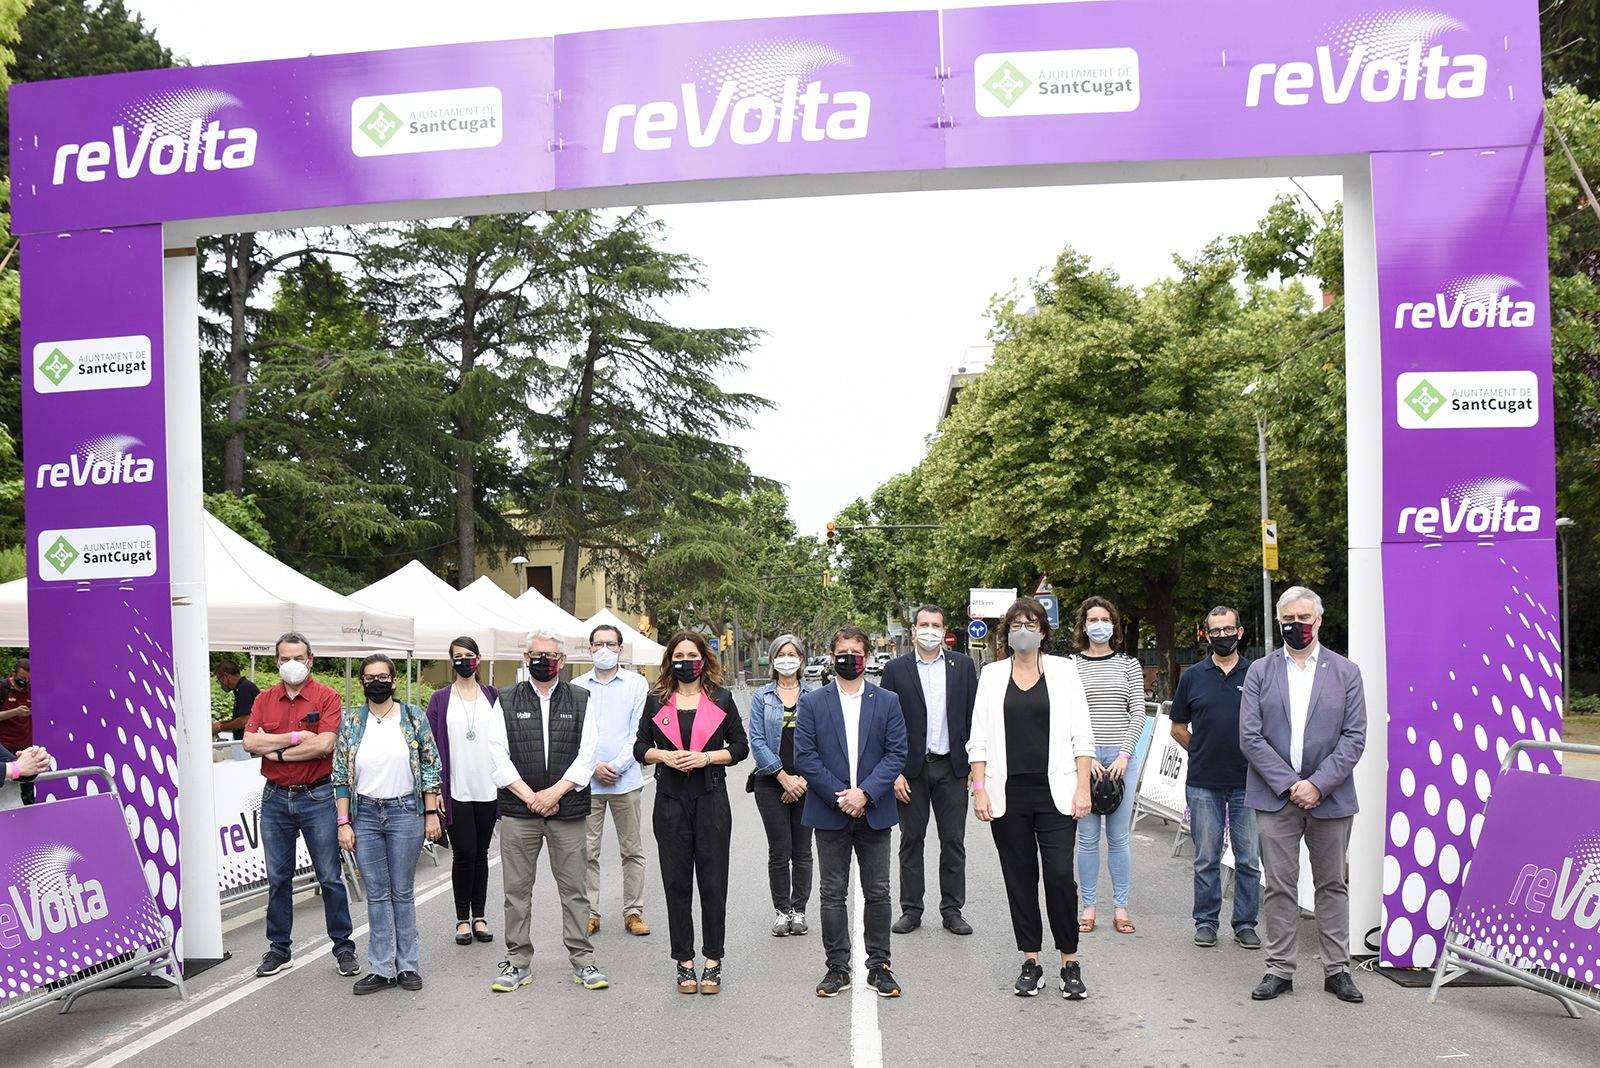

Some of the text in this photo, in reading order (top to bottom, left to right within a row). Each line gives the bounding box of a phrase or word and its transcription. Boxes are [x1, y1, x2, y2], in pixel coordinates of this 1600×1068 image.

[1039, 66, 1133, 80] AJUNTAMENT DE
[1245, 41, 1488, 107] reVolta
[1039, 79, 1133, 97] SantCugat
[408, 106, 478, 120] AJUNTAMENT
[409, 116, 496, 135] SantCugat
[601, 76, 872, 154] reVolta
[52, 118, 258, 186] reVolta
[1394, 293, 1536, 329] reVolta
[78, 360, 147, 375] SantCugat
[79, 350, 147, 363] AJUNTAMENT DE
[1452, 387, 1533, 398] AJUNTAMENT DE
[1452, 398, 1533, 414] SantCugat
[36, 451, 154, 489] reVolta
[1397, 496, 1542, 534] reVolta
[83, 540, 152, 552] AJUNTAMENT DE
[83, 550, 152, 565] SantCugat
[1159, 745, 1183, 780] Volta
[219, 809, 260, 856] reV
[1508, 857, 1600, 930] reVo
[0, 872, 109, 949] eVolta
